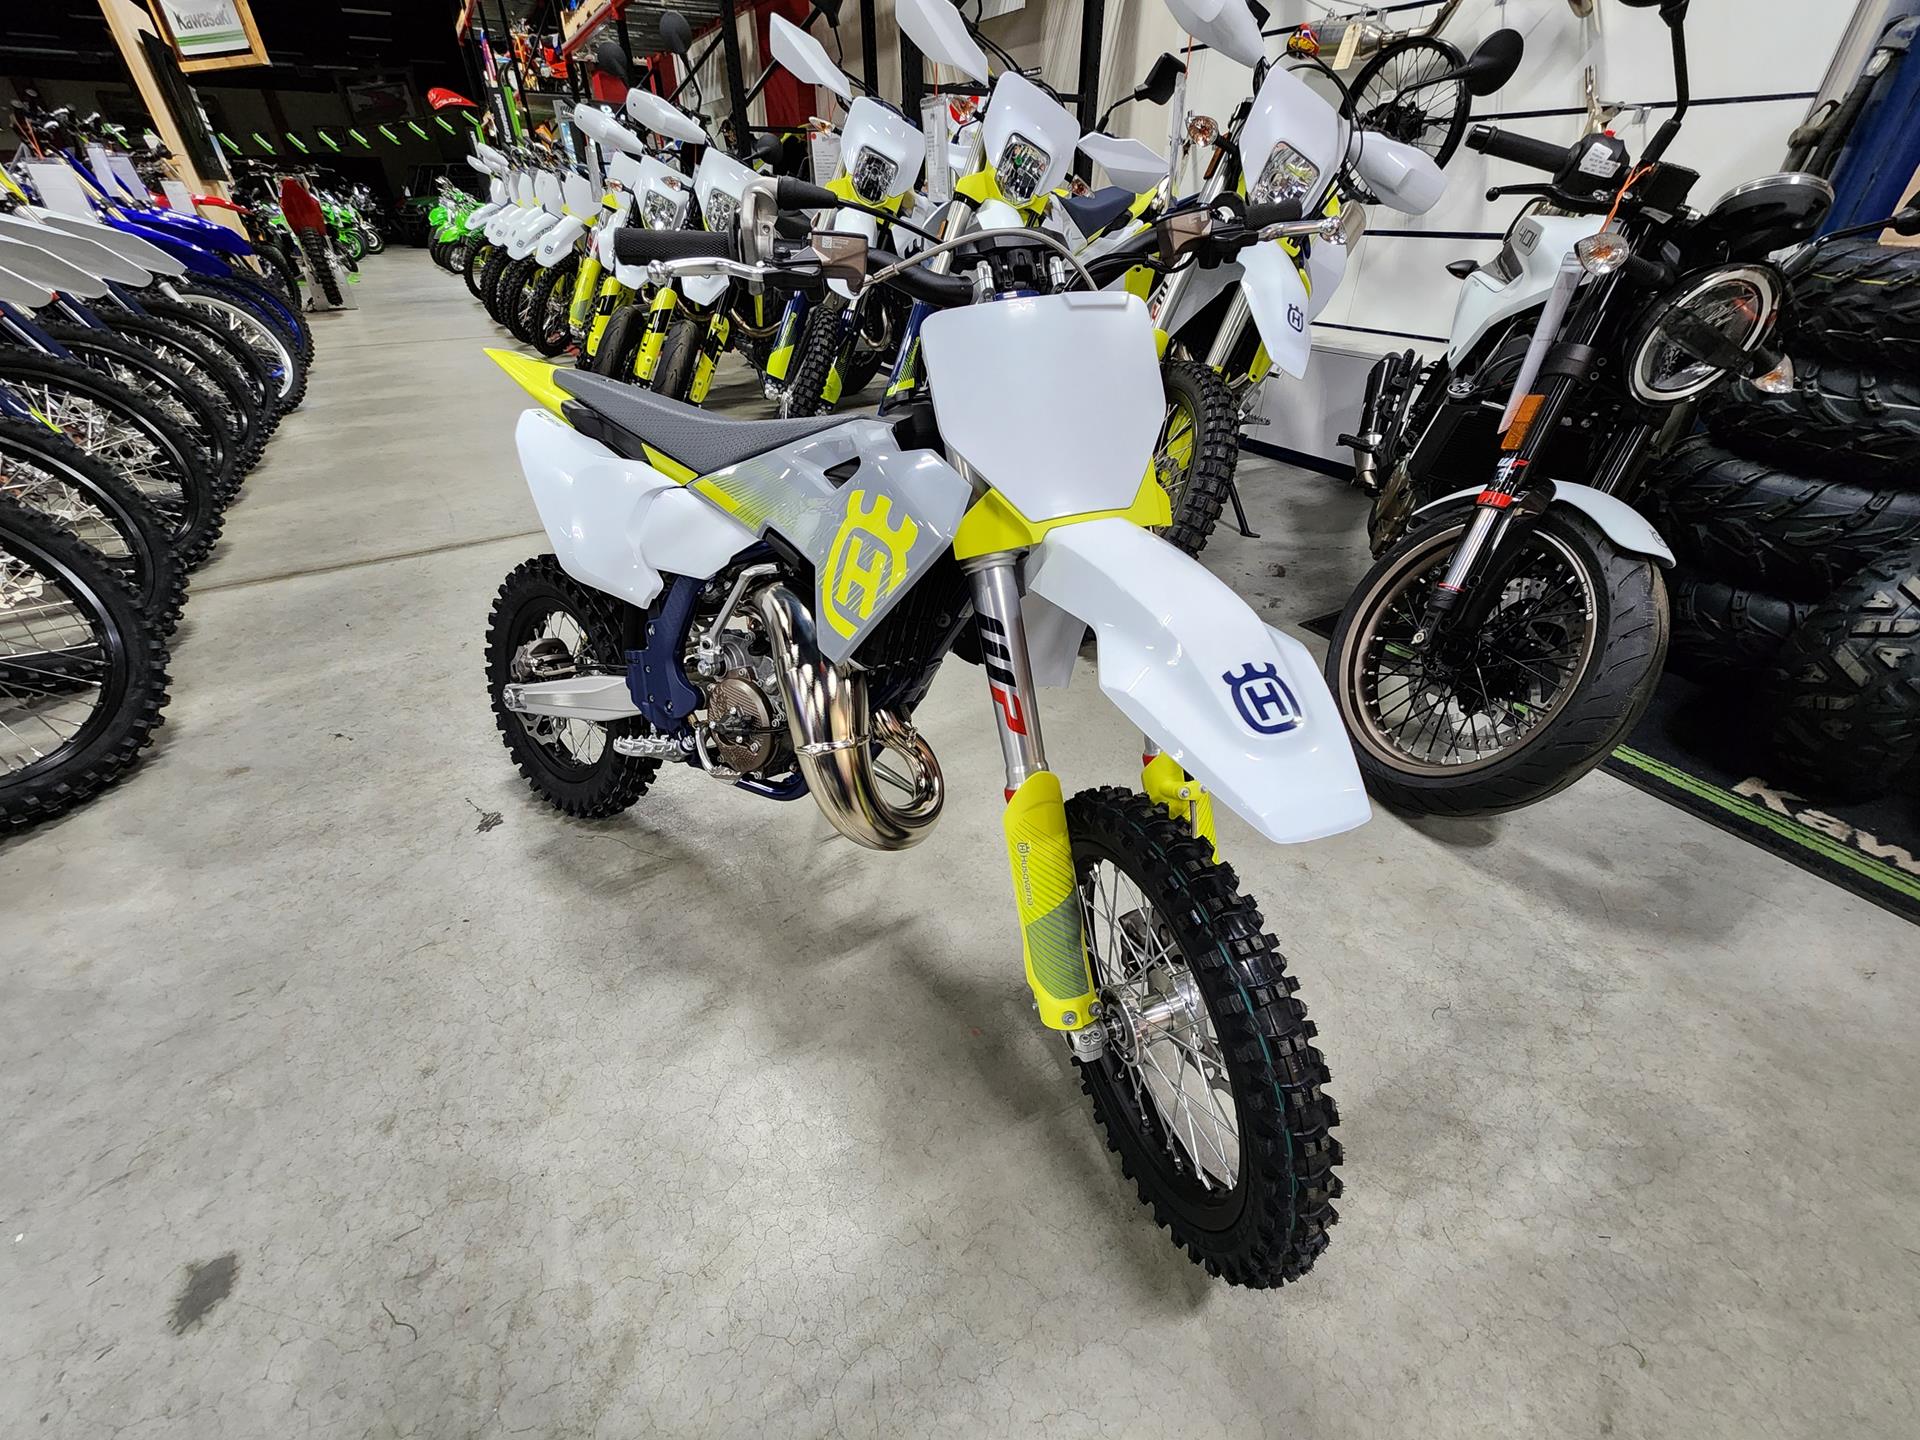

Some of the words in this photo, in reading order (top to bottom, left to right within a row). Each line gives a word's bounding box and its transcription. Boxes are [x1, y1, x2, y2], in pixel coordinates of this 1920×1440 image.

[173, 4, 233, 31] Kawasaki
[494, 93, 513, 143] Kawasaki
[1518, 225, 1538, 249] 401
[1020, 855, 1034, 906] Husqvarna
